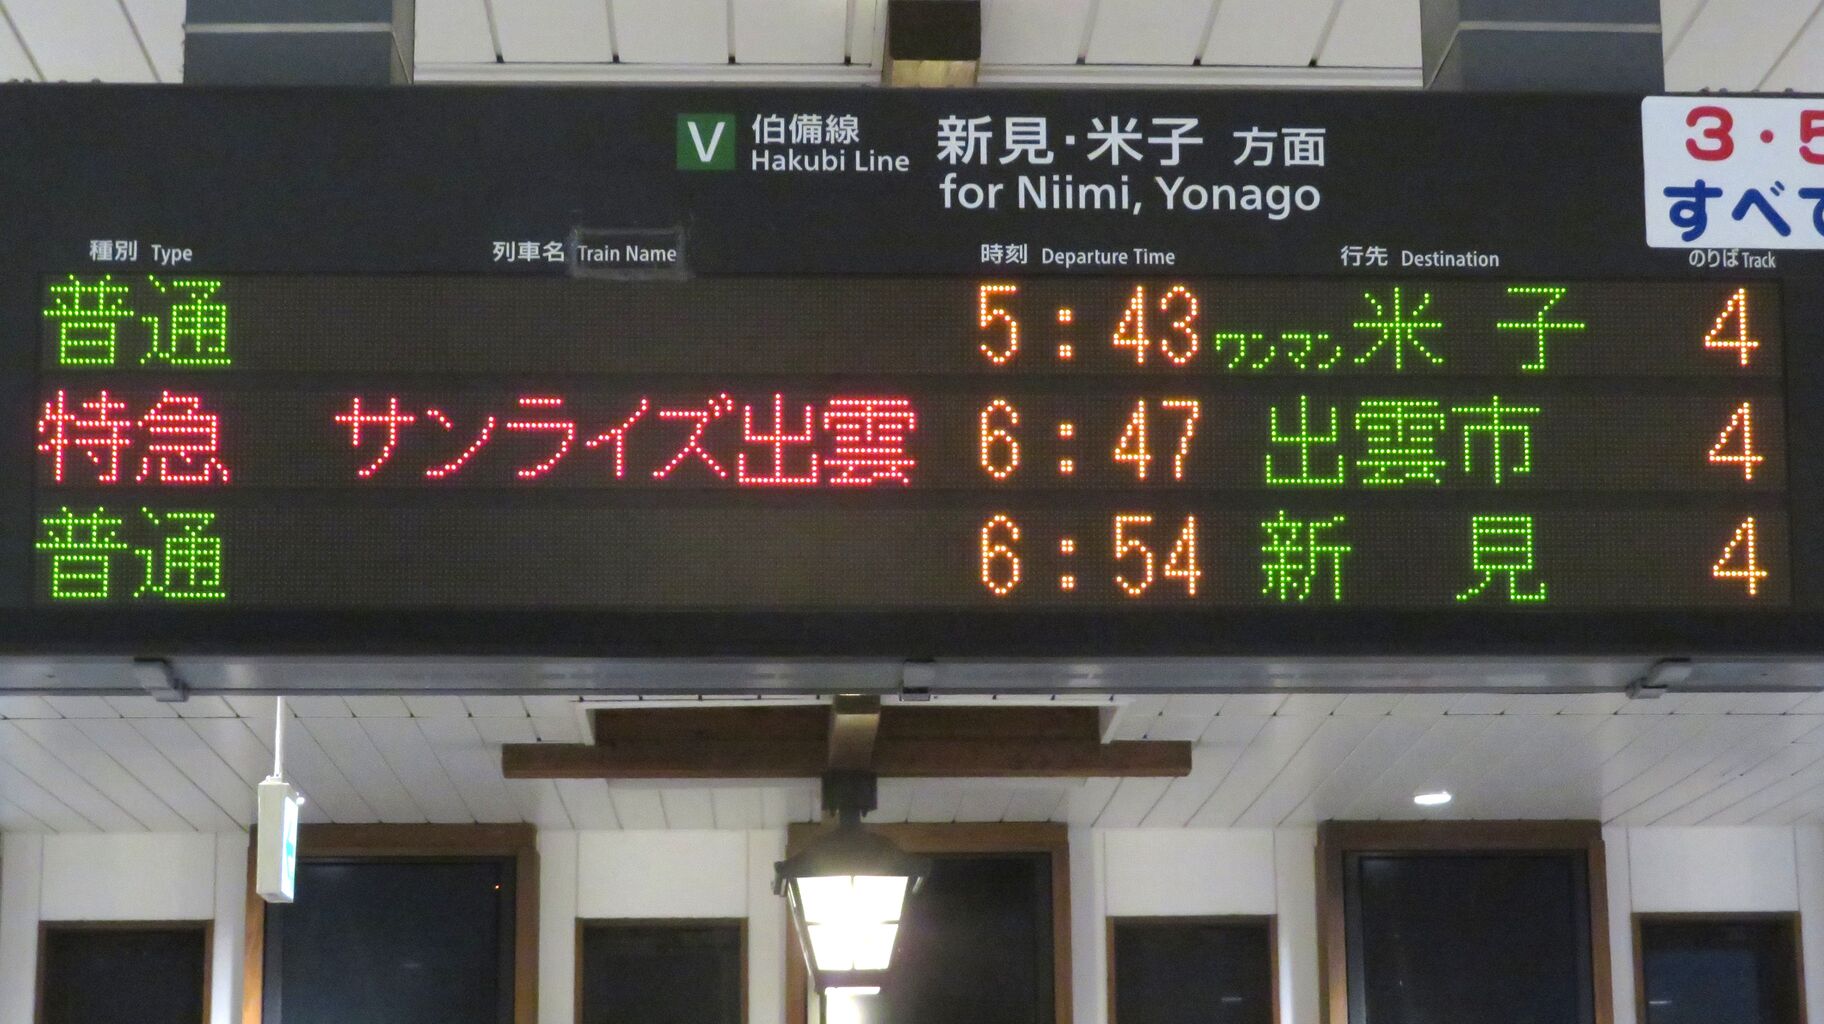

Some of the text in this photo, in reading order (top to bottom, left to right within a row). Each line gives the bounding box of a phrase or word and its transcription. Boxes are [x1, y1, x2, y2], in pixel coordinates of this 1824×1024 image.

[688, 122, 726, 163] V
[752, 114, 860, 145] 伯備線
[937, 115, 1326, 167] 新見・米子 方面
[752, 149, 910, 172] Hakubi Line
[939, 173, 1321, 221] for Niimi, Yonago
[89, 239, 193, 266] 種別 Type
[492, 240, 677, 262] 列車名 Train Name
[981, 243, 1175, 269] 時刻 Departure Time
[1340, 245, 1500, 267] 行先 Destination
[1689, 249, 1776, 268] のりば Track
[43, 274, 232, 365] 普通
[1704, 287, 1760, 366] 4
[1215, 333, 1342, 369] ワンマン
[37, 389, 231, 485] 特急
[335, 392, 918, 488] サンライズ出雲
[1266, 394, 1541, 485] 出雲市
[1708, 401, 1764, 481] 4
[35, 506, 226, 599] 普通
[1712, 516, 1768, 596] 4
